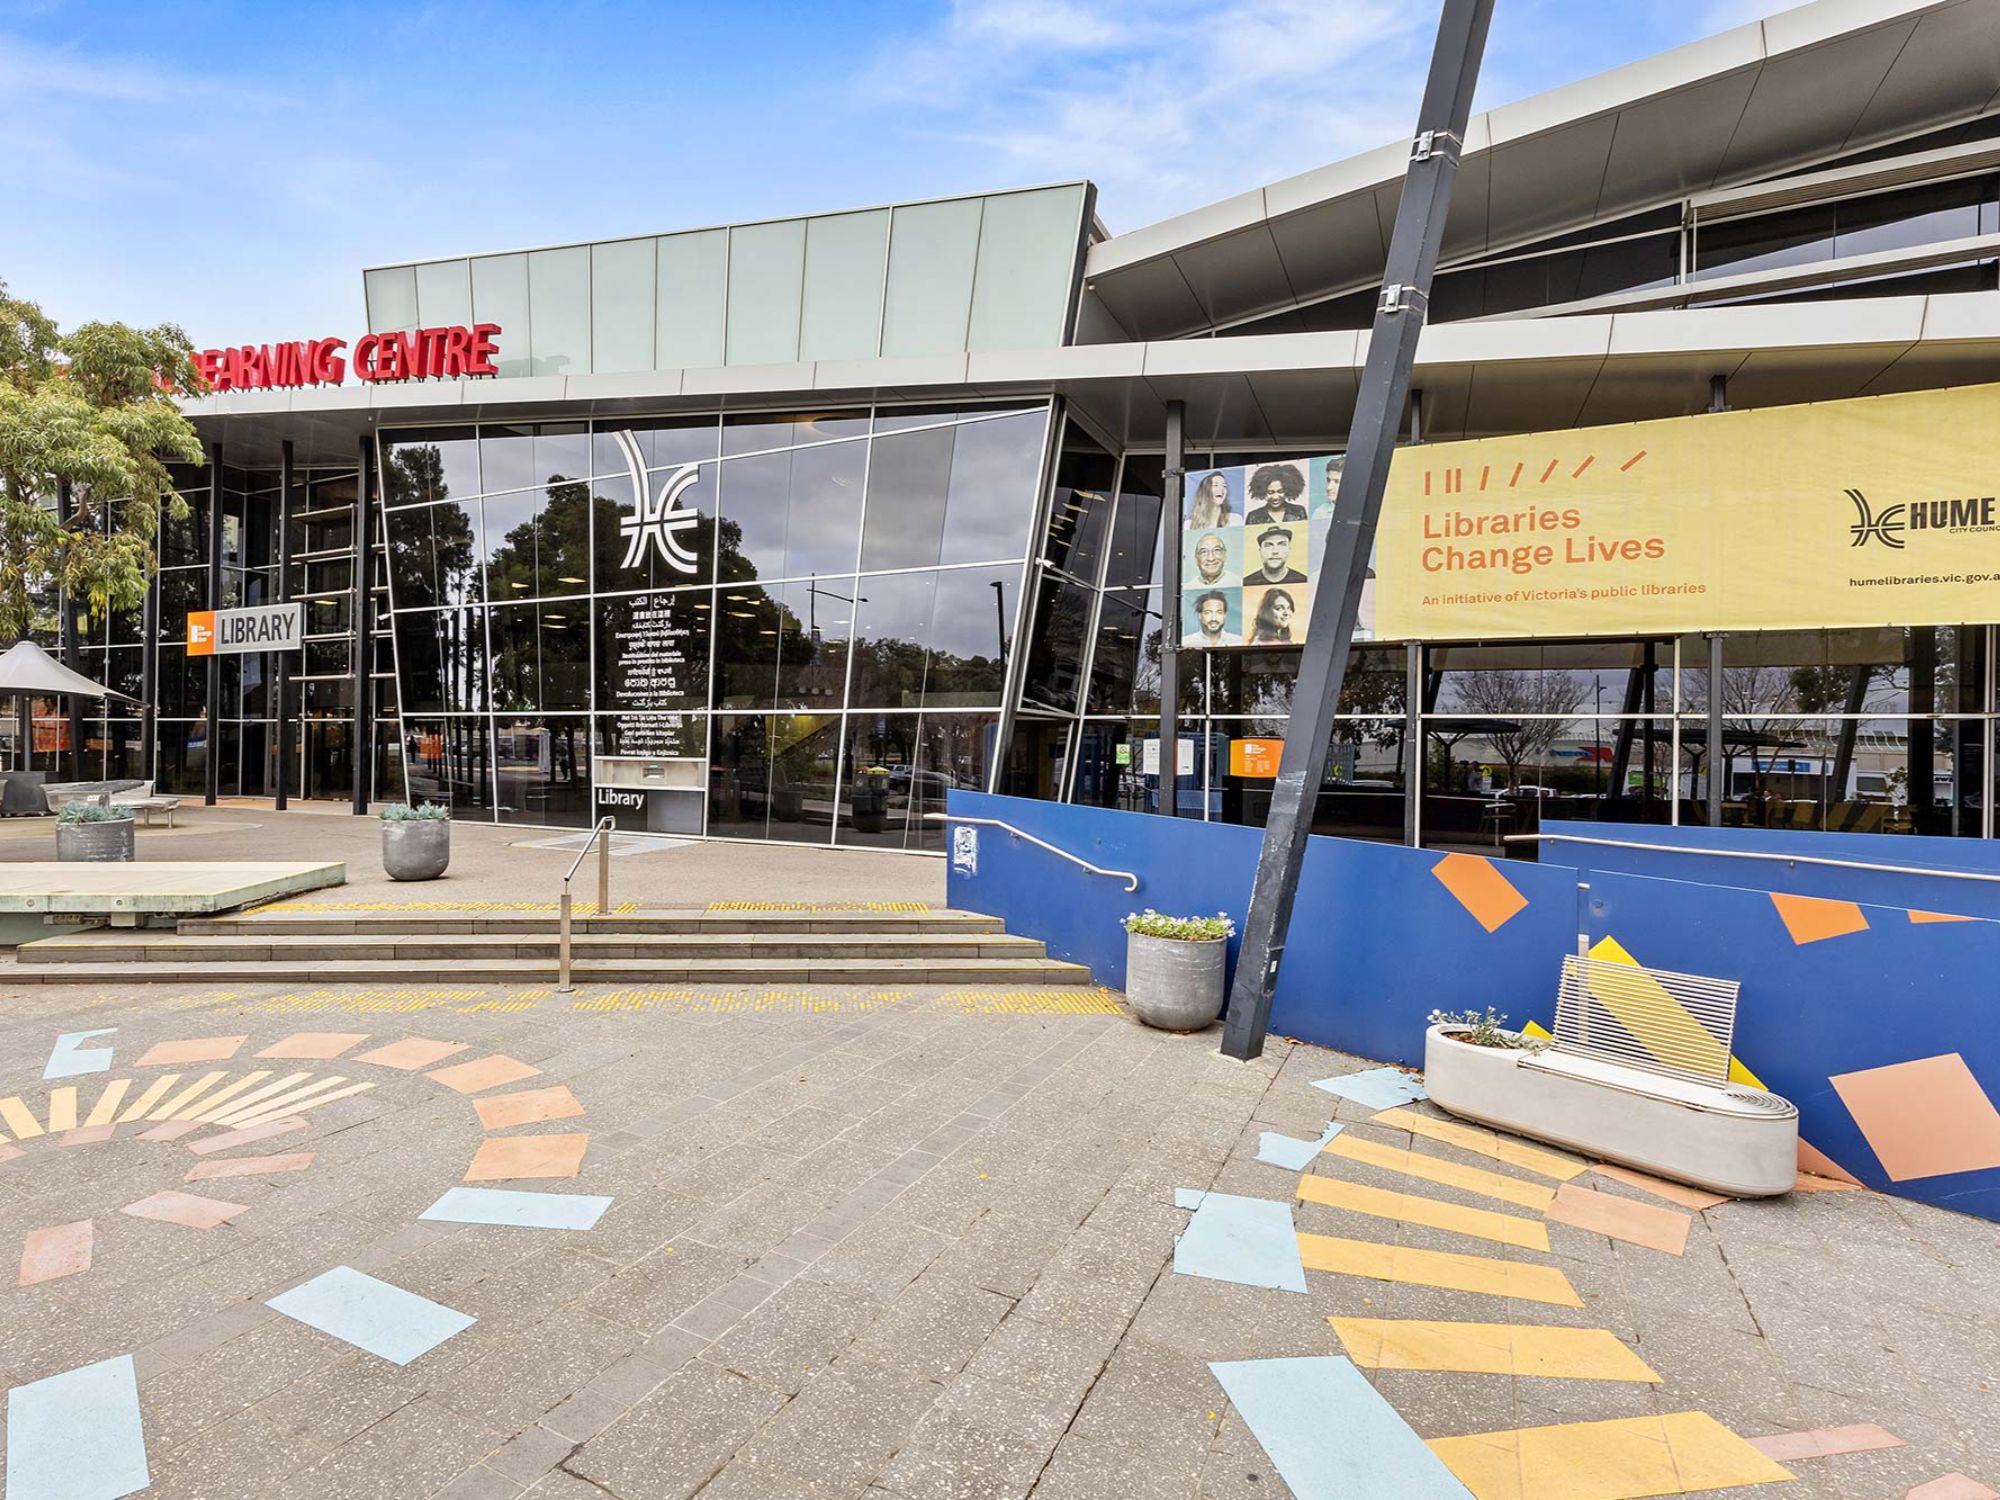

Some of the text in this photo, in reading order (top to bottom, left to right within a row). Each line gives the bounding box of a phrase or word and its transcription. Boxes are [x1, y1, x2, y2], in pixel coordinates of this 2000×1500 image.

[354, 323, 502, 384] CENTRE
[1423, 506, 1581, 539] Libraries
[1909, 497, 1996, 530] HUME
[1422, 536, 1665, 575] Change Lives
[1422, 582, 1707, 605] An initiative of Victoria's public libraries
[221, 612, 295, 645] LIBRARY
[598, 788, 645, 810] Library
